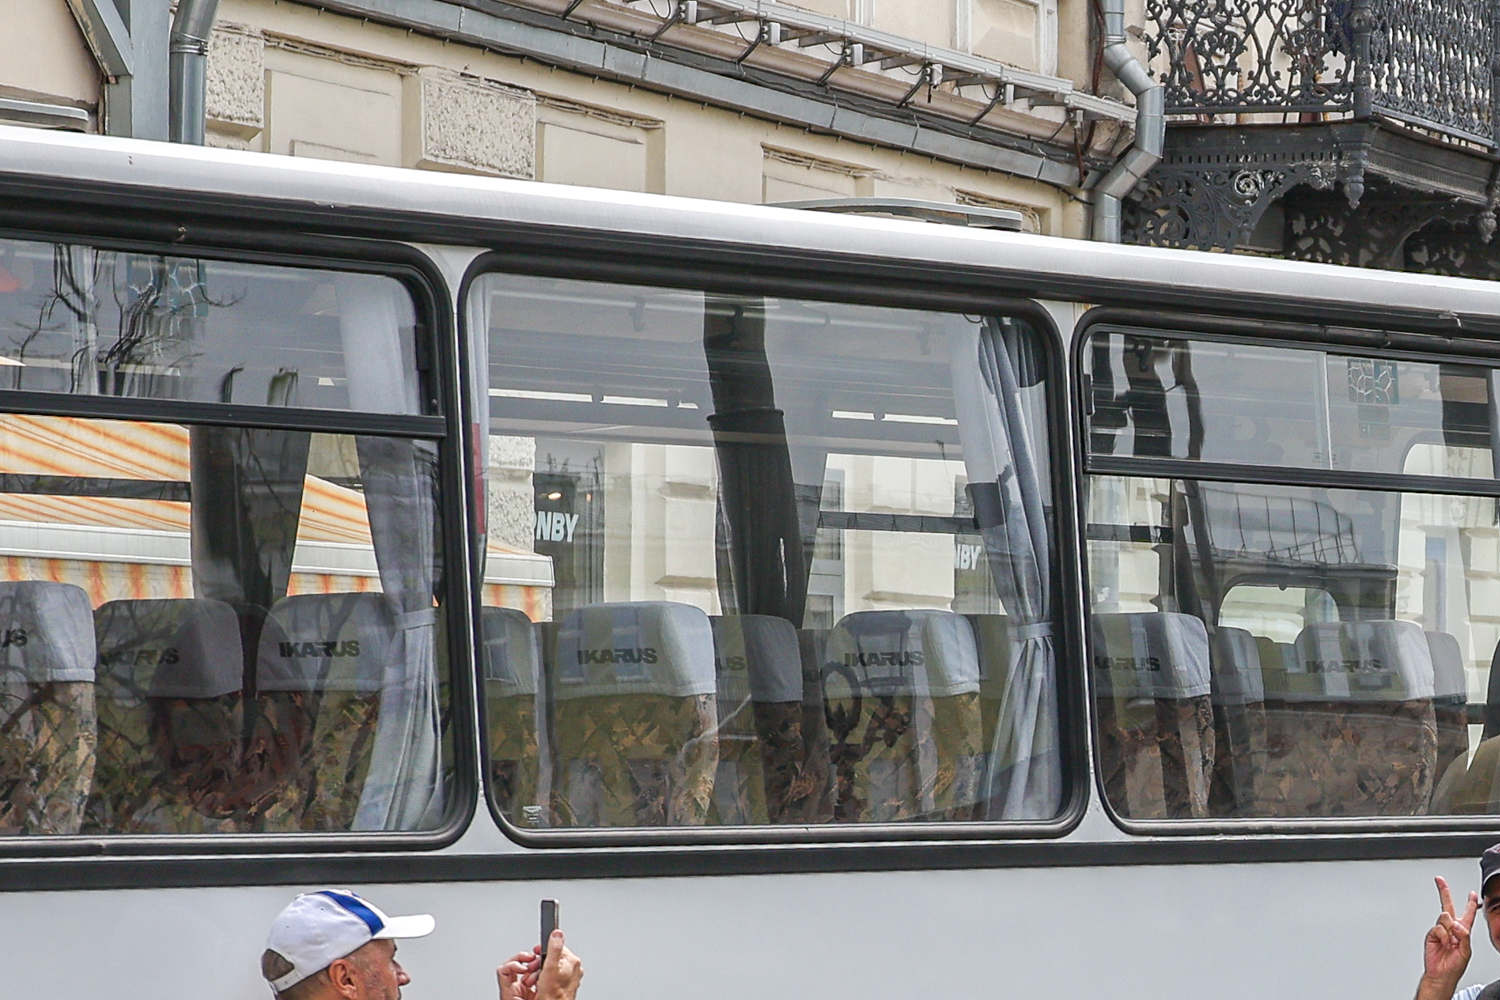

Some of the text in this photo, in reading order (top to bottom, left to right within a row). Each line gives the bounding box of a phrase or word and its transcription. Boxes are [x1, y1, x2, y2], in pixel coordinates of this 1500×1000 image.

[534, 511, 579, 543] NBY
[279, 640, 361, 659] IKARUS
[578, 648, 658, 666] IKARUS
[844, 651, 925, 668] IKARUS
